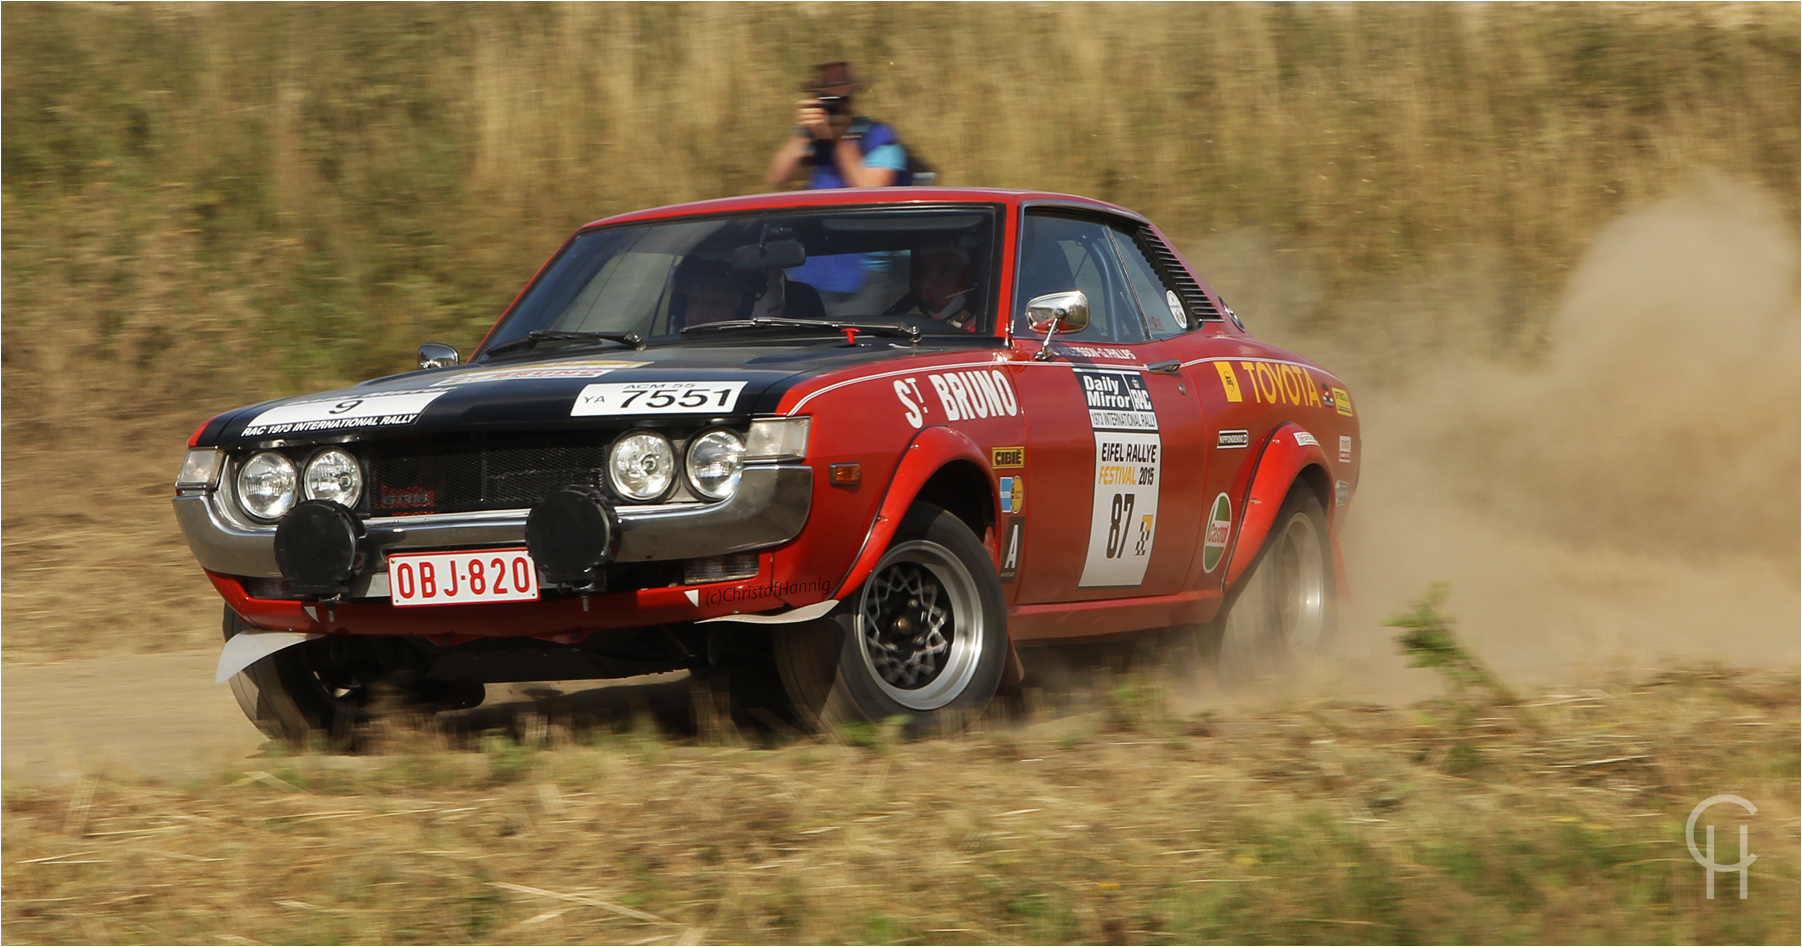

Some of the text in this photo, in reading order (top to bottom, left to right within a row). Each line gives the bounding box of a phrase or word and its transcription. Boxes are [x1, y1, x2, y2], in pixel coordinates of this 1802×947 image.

[928, 369, 1018, 422] BRUNO
[1083, 375, 1119, 396] Daily
[1240, 361, 1322, 408] TOYOTA
[328, 399, 365, 414] 9
[584, 388, 733, 409] YA 7551
[1086, 391, 1131, 408] Mirror
[1130, 388, 1153, 410] RAC
[241, 413, 418, 437] RAC 1973 INTERNATIONAL RALLY
[1091, 411, 1156, 428] 1973 INTERNATIONAL RALLY
[1101, 442, 1157, 464] EIFEL RALLYE
[1098, 465, 1154, 486] FESTIVAL 2015
[1105, 493, 1136, 559] 87
[1207, 523, 1229, 545] Castrol
[1004, 524, 1019, 569] A
